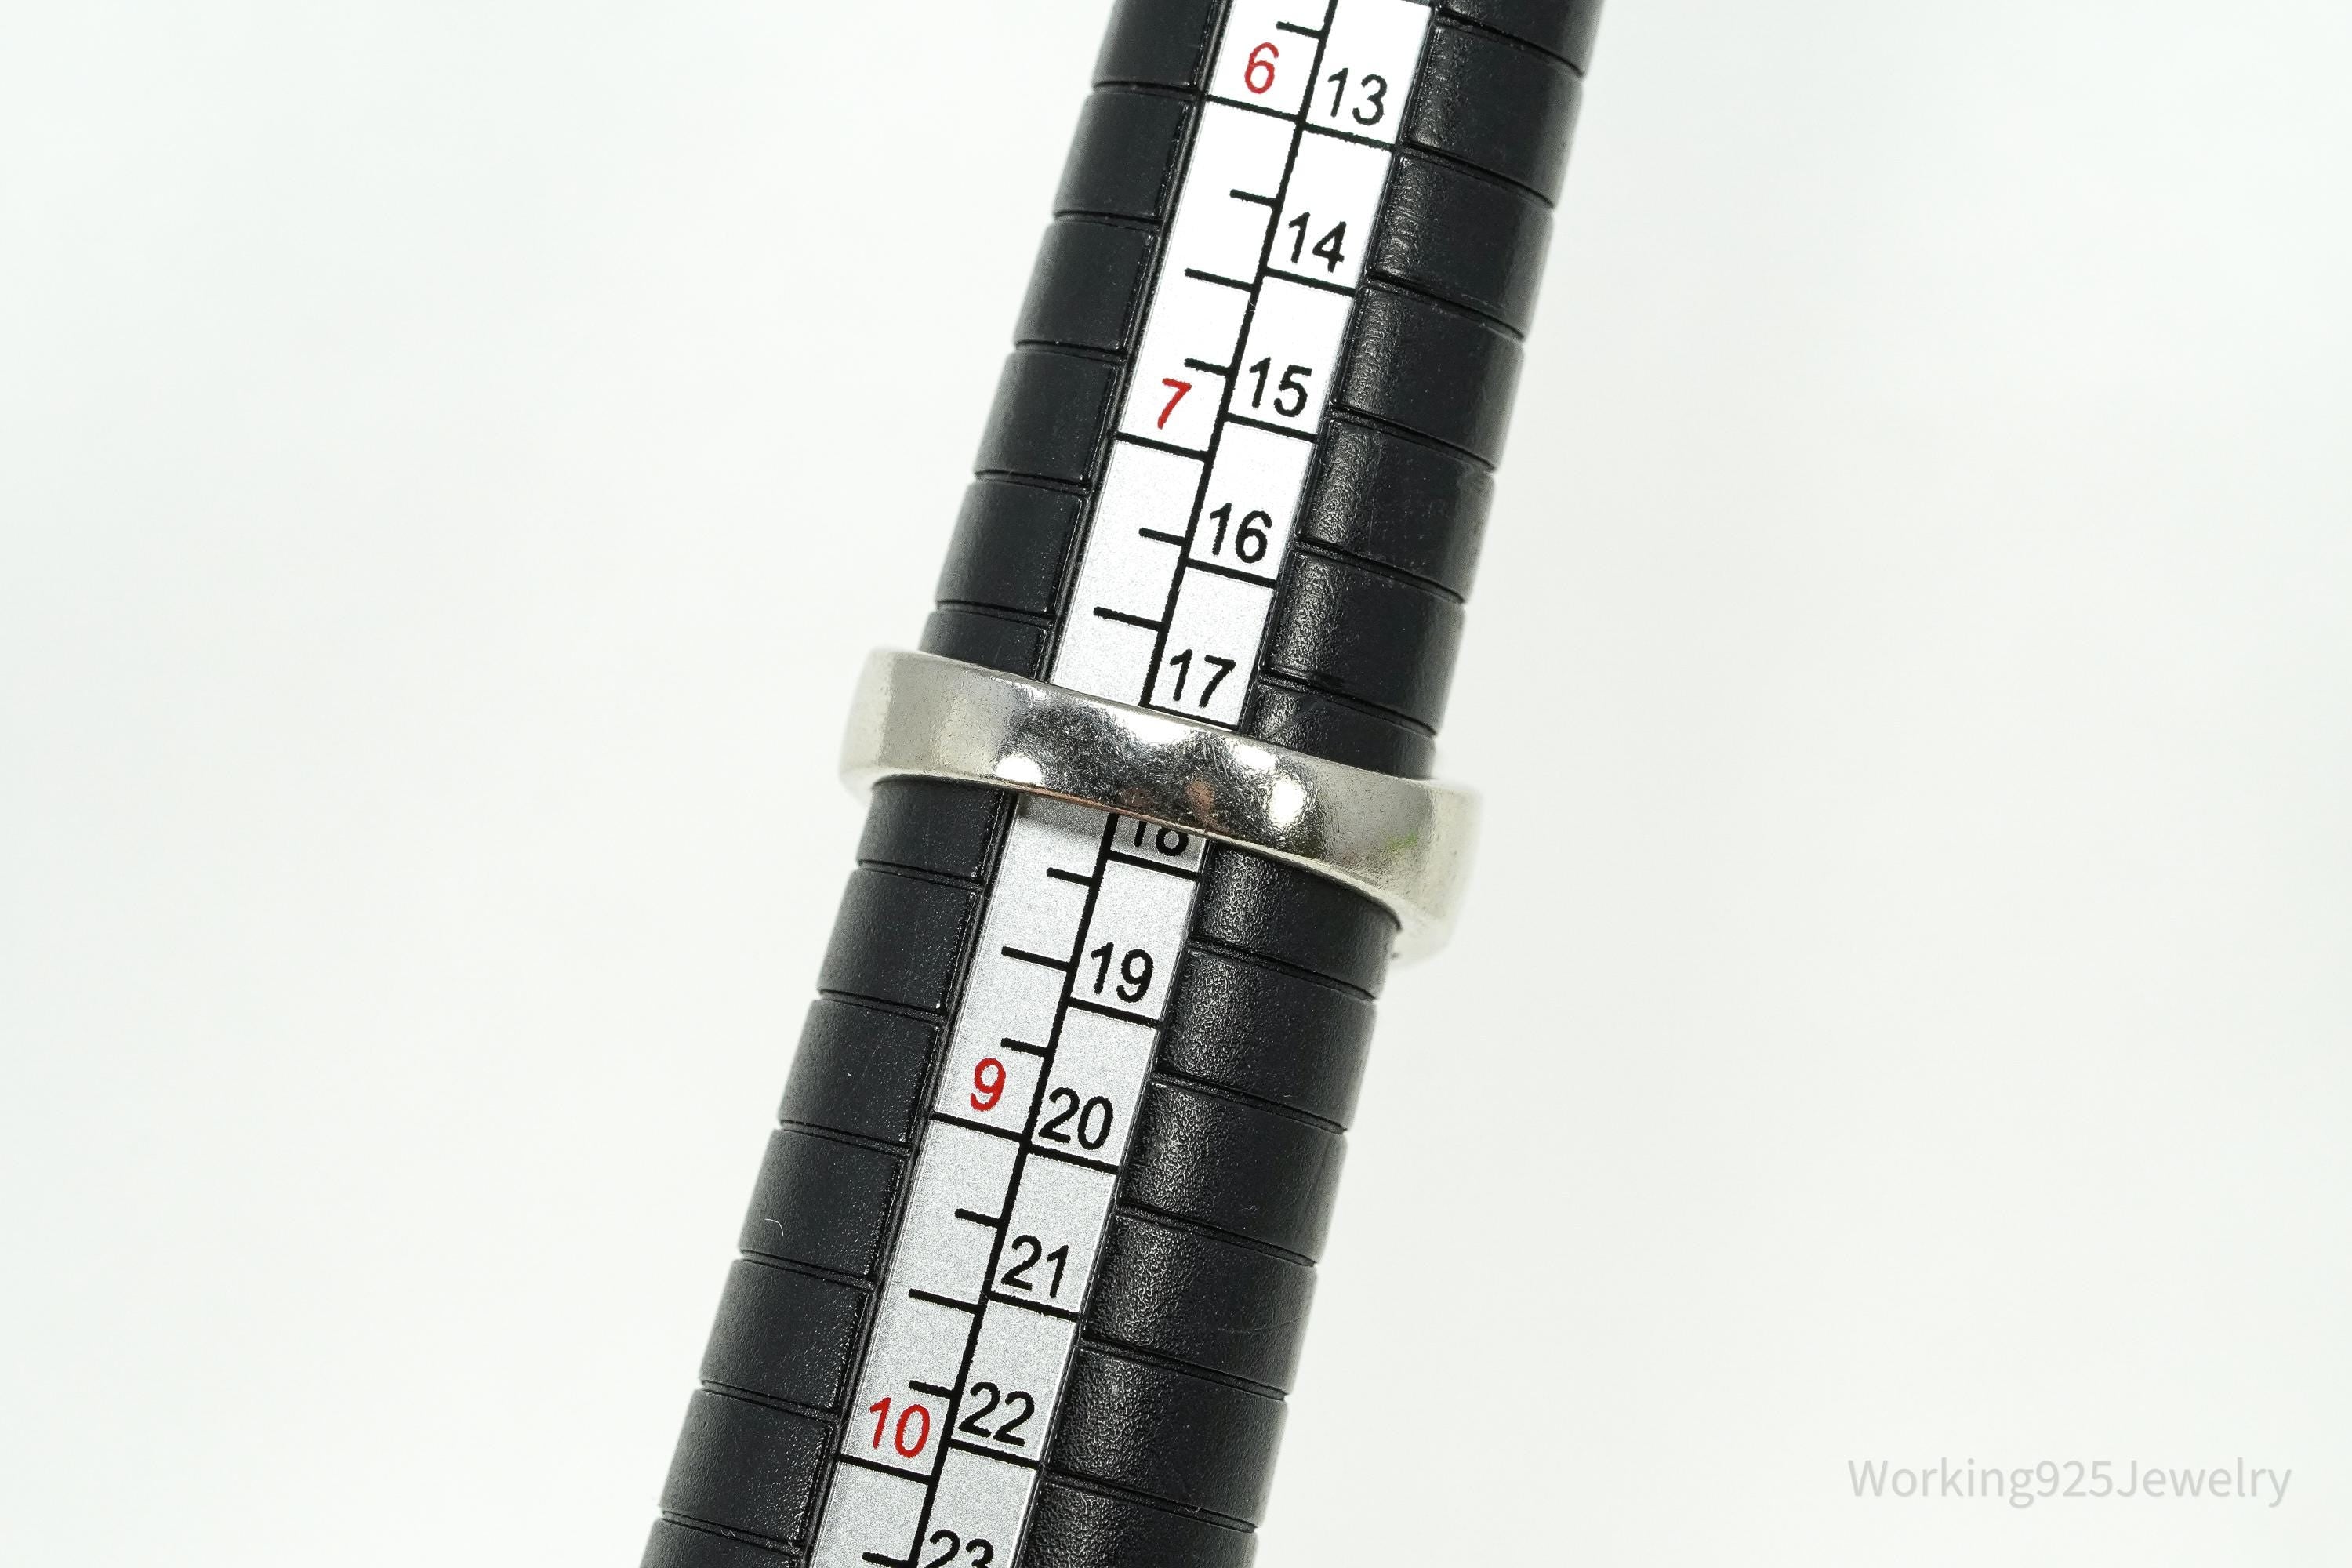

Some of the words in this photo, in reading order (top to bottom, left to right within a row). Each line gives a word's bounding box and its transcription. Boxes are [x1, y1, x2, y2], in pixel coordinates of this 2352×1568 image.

[1244, 42, 1279, 93] 6
[1328, 68, 1388, 126] 13
[1288, 212, 1347, 273] 14
[1157, 378, 1192, 429] 7
[1249, 358, 1312, 418] 15
[1209, 503, 1272, 564] 16
[1169, 649, 1236, 709] 17
[1091, 942, 1155, 1004] 19
[970, 1058, 1007, 1112] 9
[1037, 1087, 1114, 1151] 20
[1000, 1235, 1069, 1299] 21
[869, 1397, 931, 1459] 10
[957, 1382, 1036, 1448] 22
